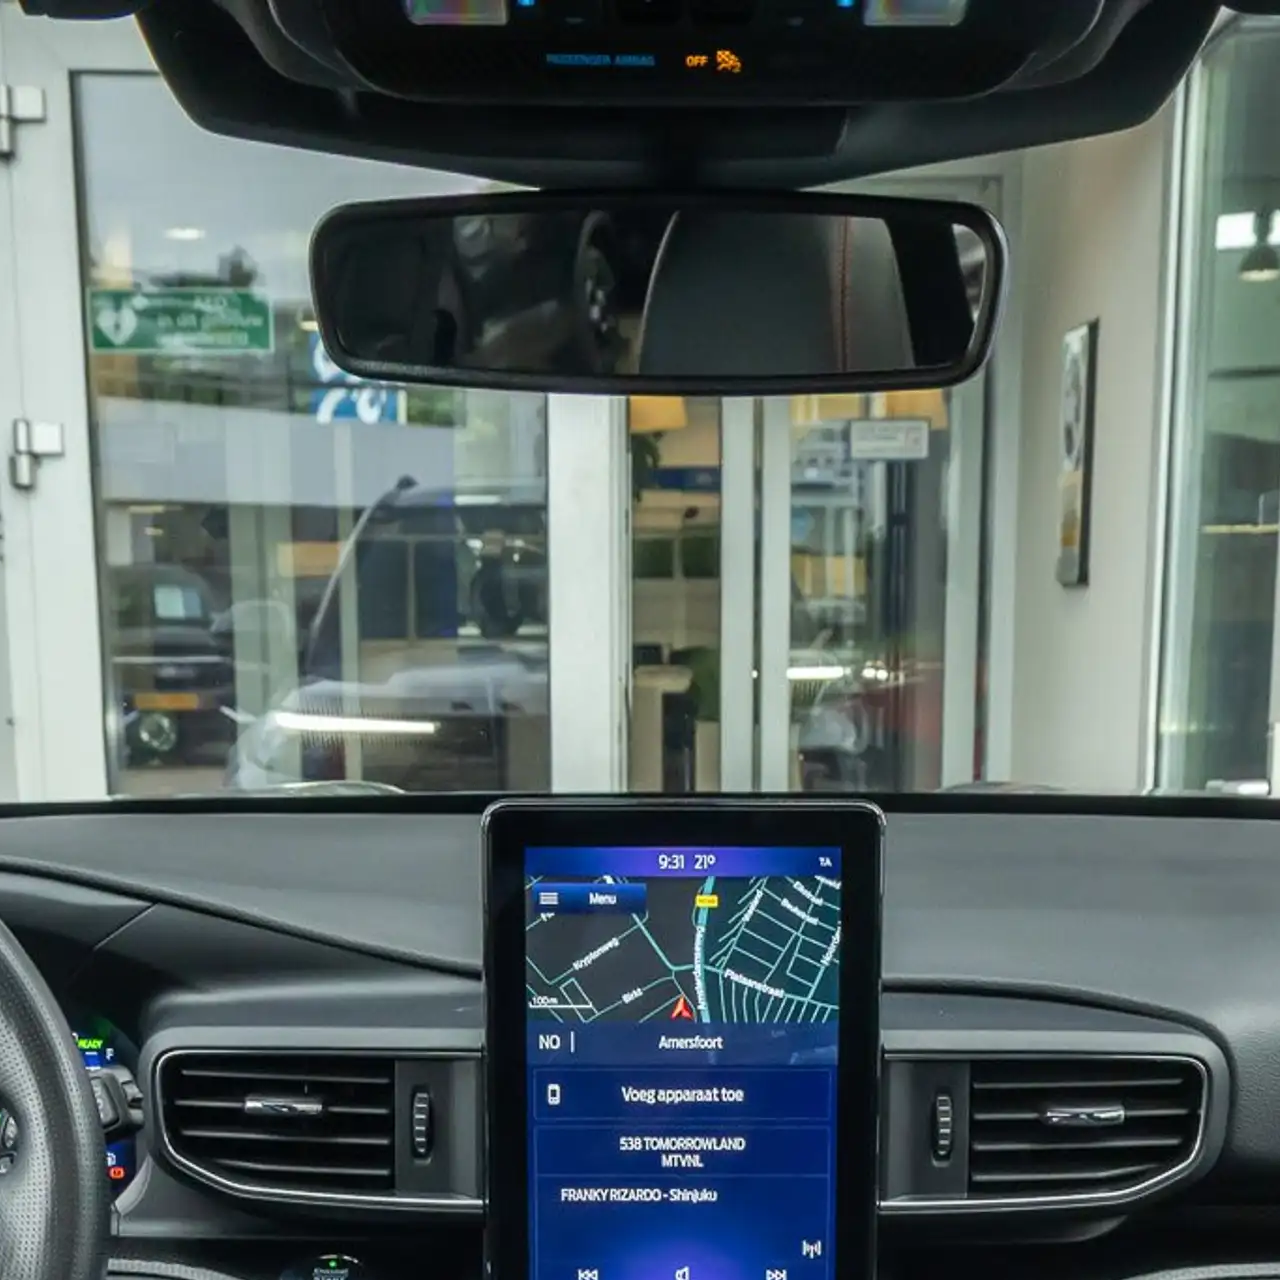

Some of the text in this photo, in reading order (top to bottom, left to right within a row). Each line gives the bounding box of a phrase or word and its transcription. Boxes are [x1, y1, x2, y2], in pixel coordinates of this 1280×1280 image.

[686, 55, 709, 67] OFF
[658, 854, 685, 869] 9:31
[589, 891, 617, 905] Menu
[538, 1034, 561, 1050] NO
[658, 1035, 724, 1050] Amersfoort
[621, 1085, 745, 1105] Voeg apparaat toe
[643, 1136, 747, 1150] TOMORROWLAND
[561, 1187, 609, 1202] FRANKY
[609, 1187, 662, 1202] RIZARDO
[669, 1187, 719, 1204] Shinjuku
